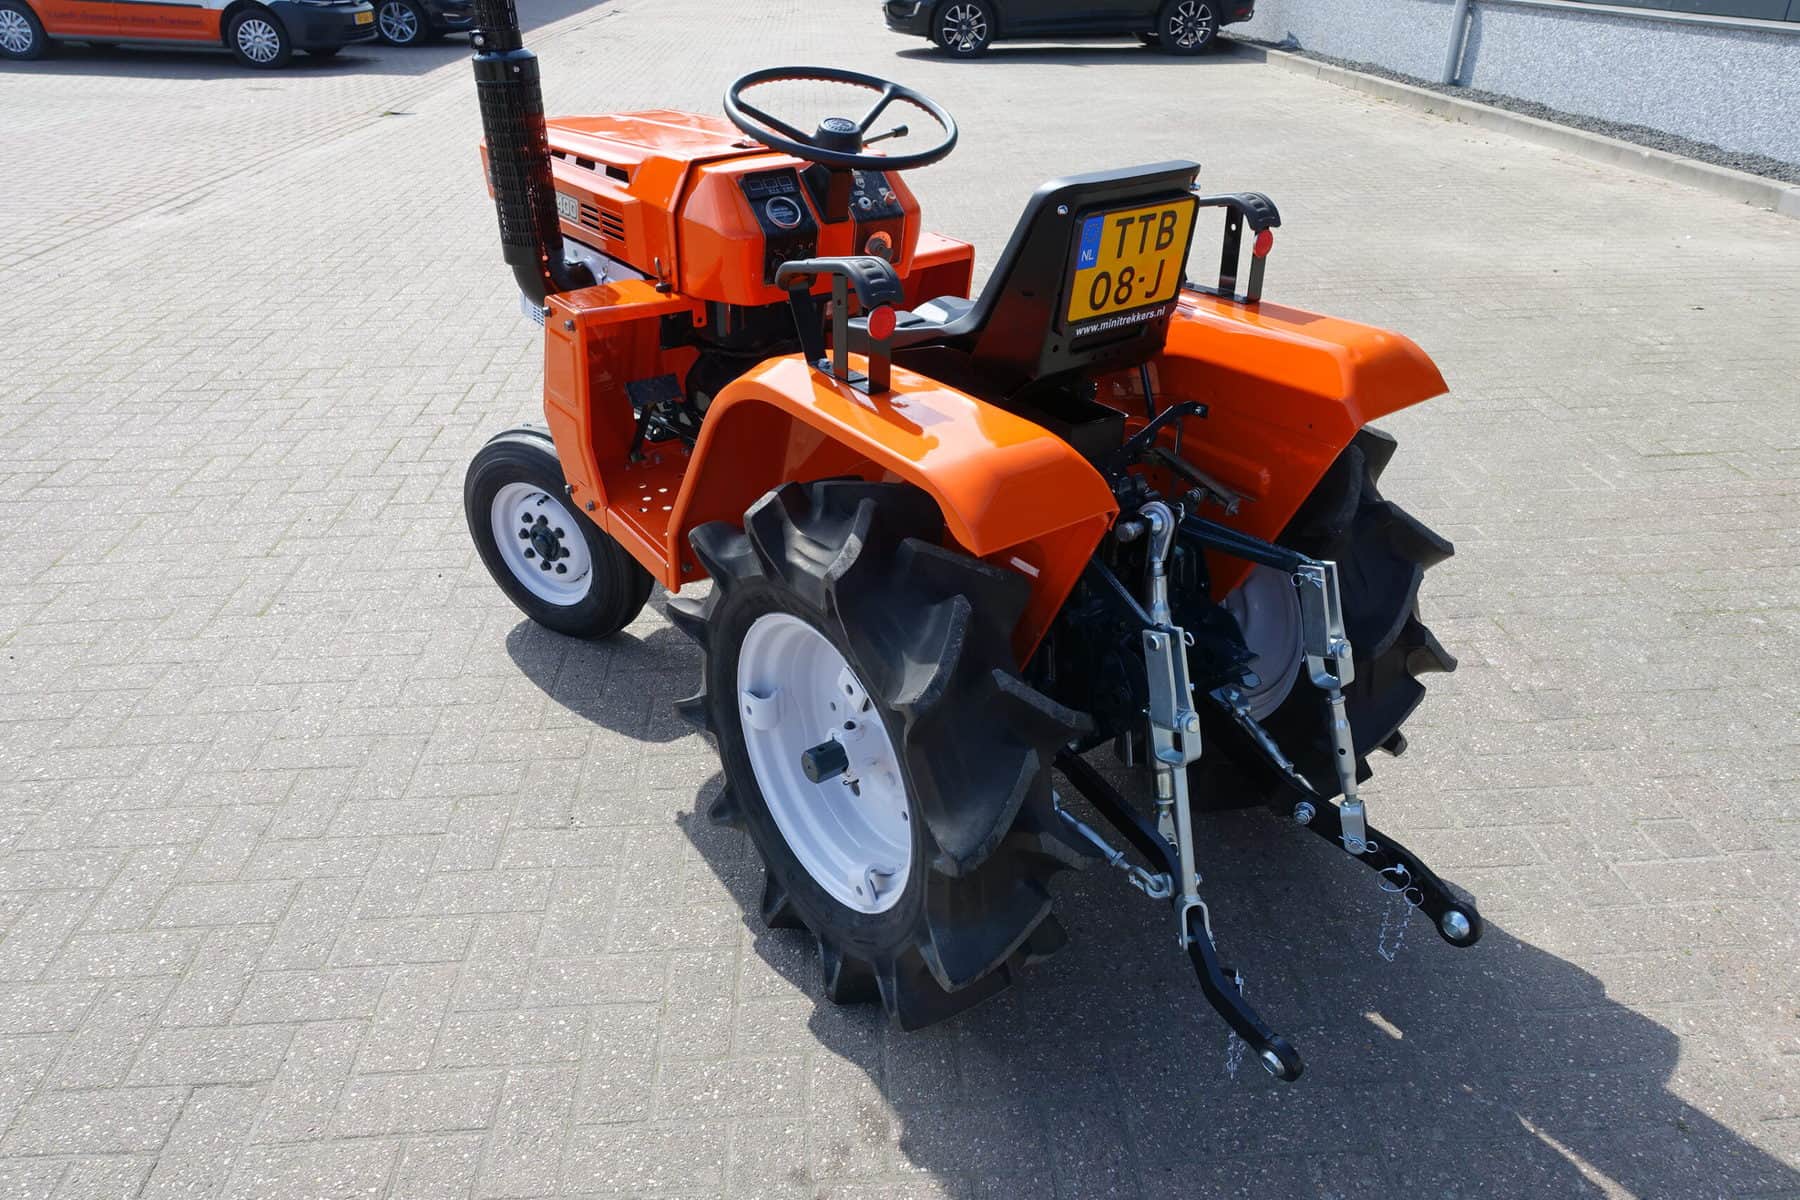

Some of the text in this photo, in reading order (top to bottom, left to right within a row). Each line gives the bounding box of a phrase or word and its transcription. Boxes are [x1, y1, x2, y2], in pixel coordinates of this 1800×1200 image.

[1115, 210, 1178, 259] TTB
[1081, 250, 1095, 262] NL
[1075, 306, 1166, 337] www.minitrekkers.nl
